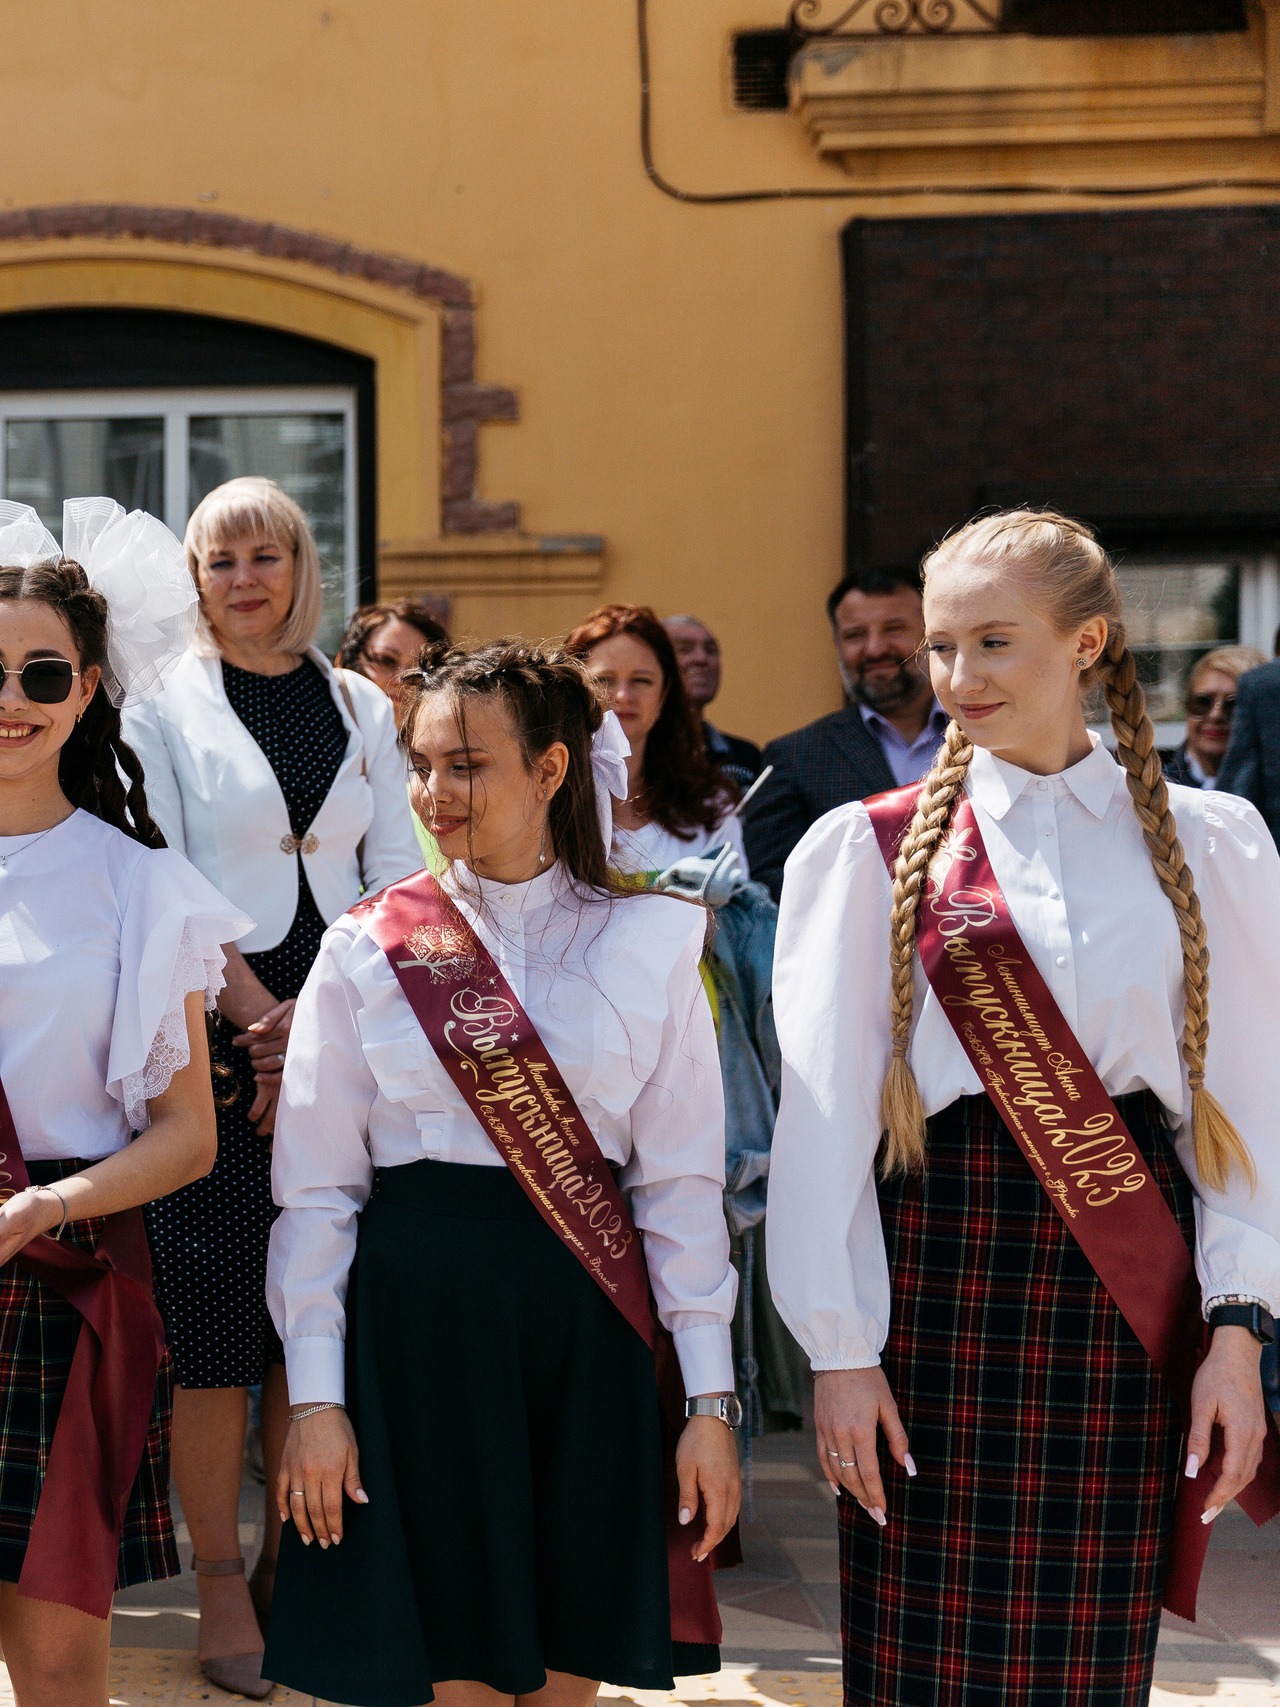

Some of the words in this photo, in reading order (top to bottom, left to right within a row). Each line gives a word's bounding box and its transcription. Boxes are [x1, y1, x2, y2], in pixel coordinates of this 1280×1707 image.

[930, 885, 1066, 1126] Выпускница
[1044, 1113, 1146, 1206] 2023
[1047, 1052, 1084, 1101] Анна
[450, 987, 584, 1199] Выпускница
[572, 1183, 632, 1259] 2023
[523, 1057, 566, 1114] Матвеева
[554, 1113, 580, 1147] Анна
[589, 1255, 619, 1293] Фролово
